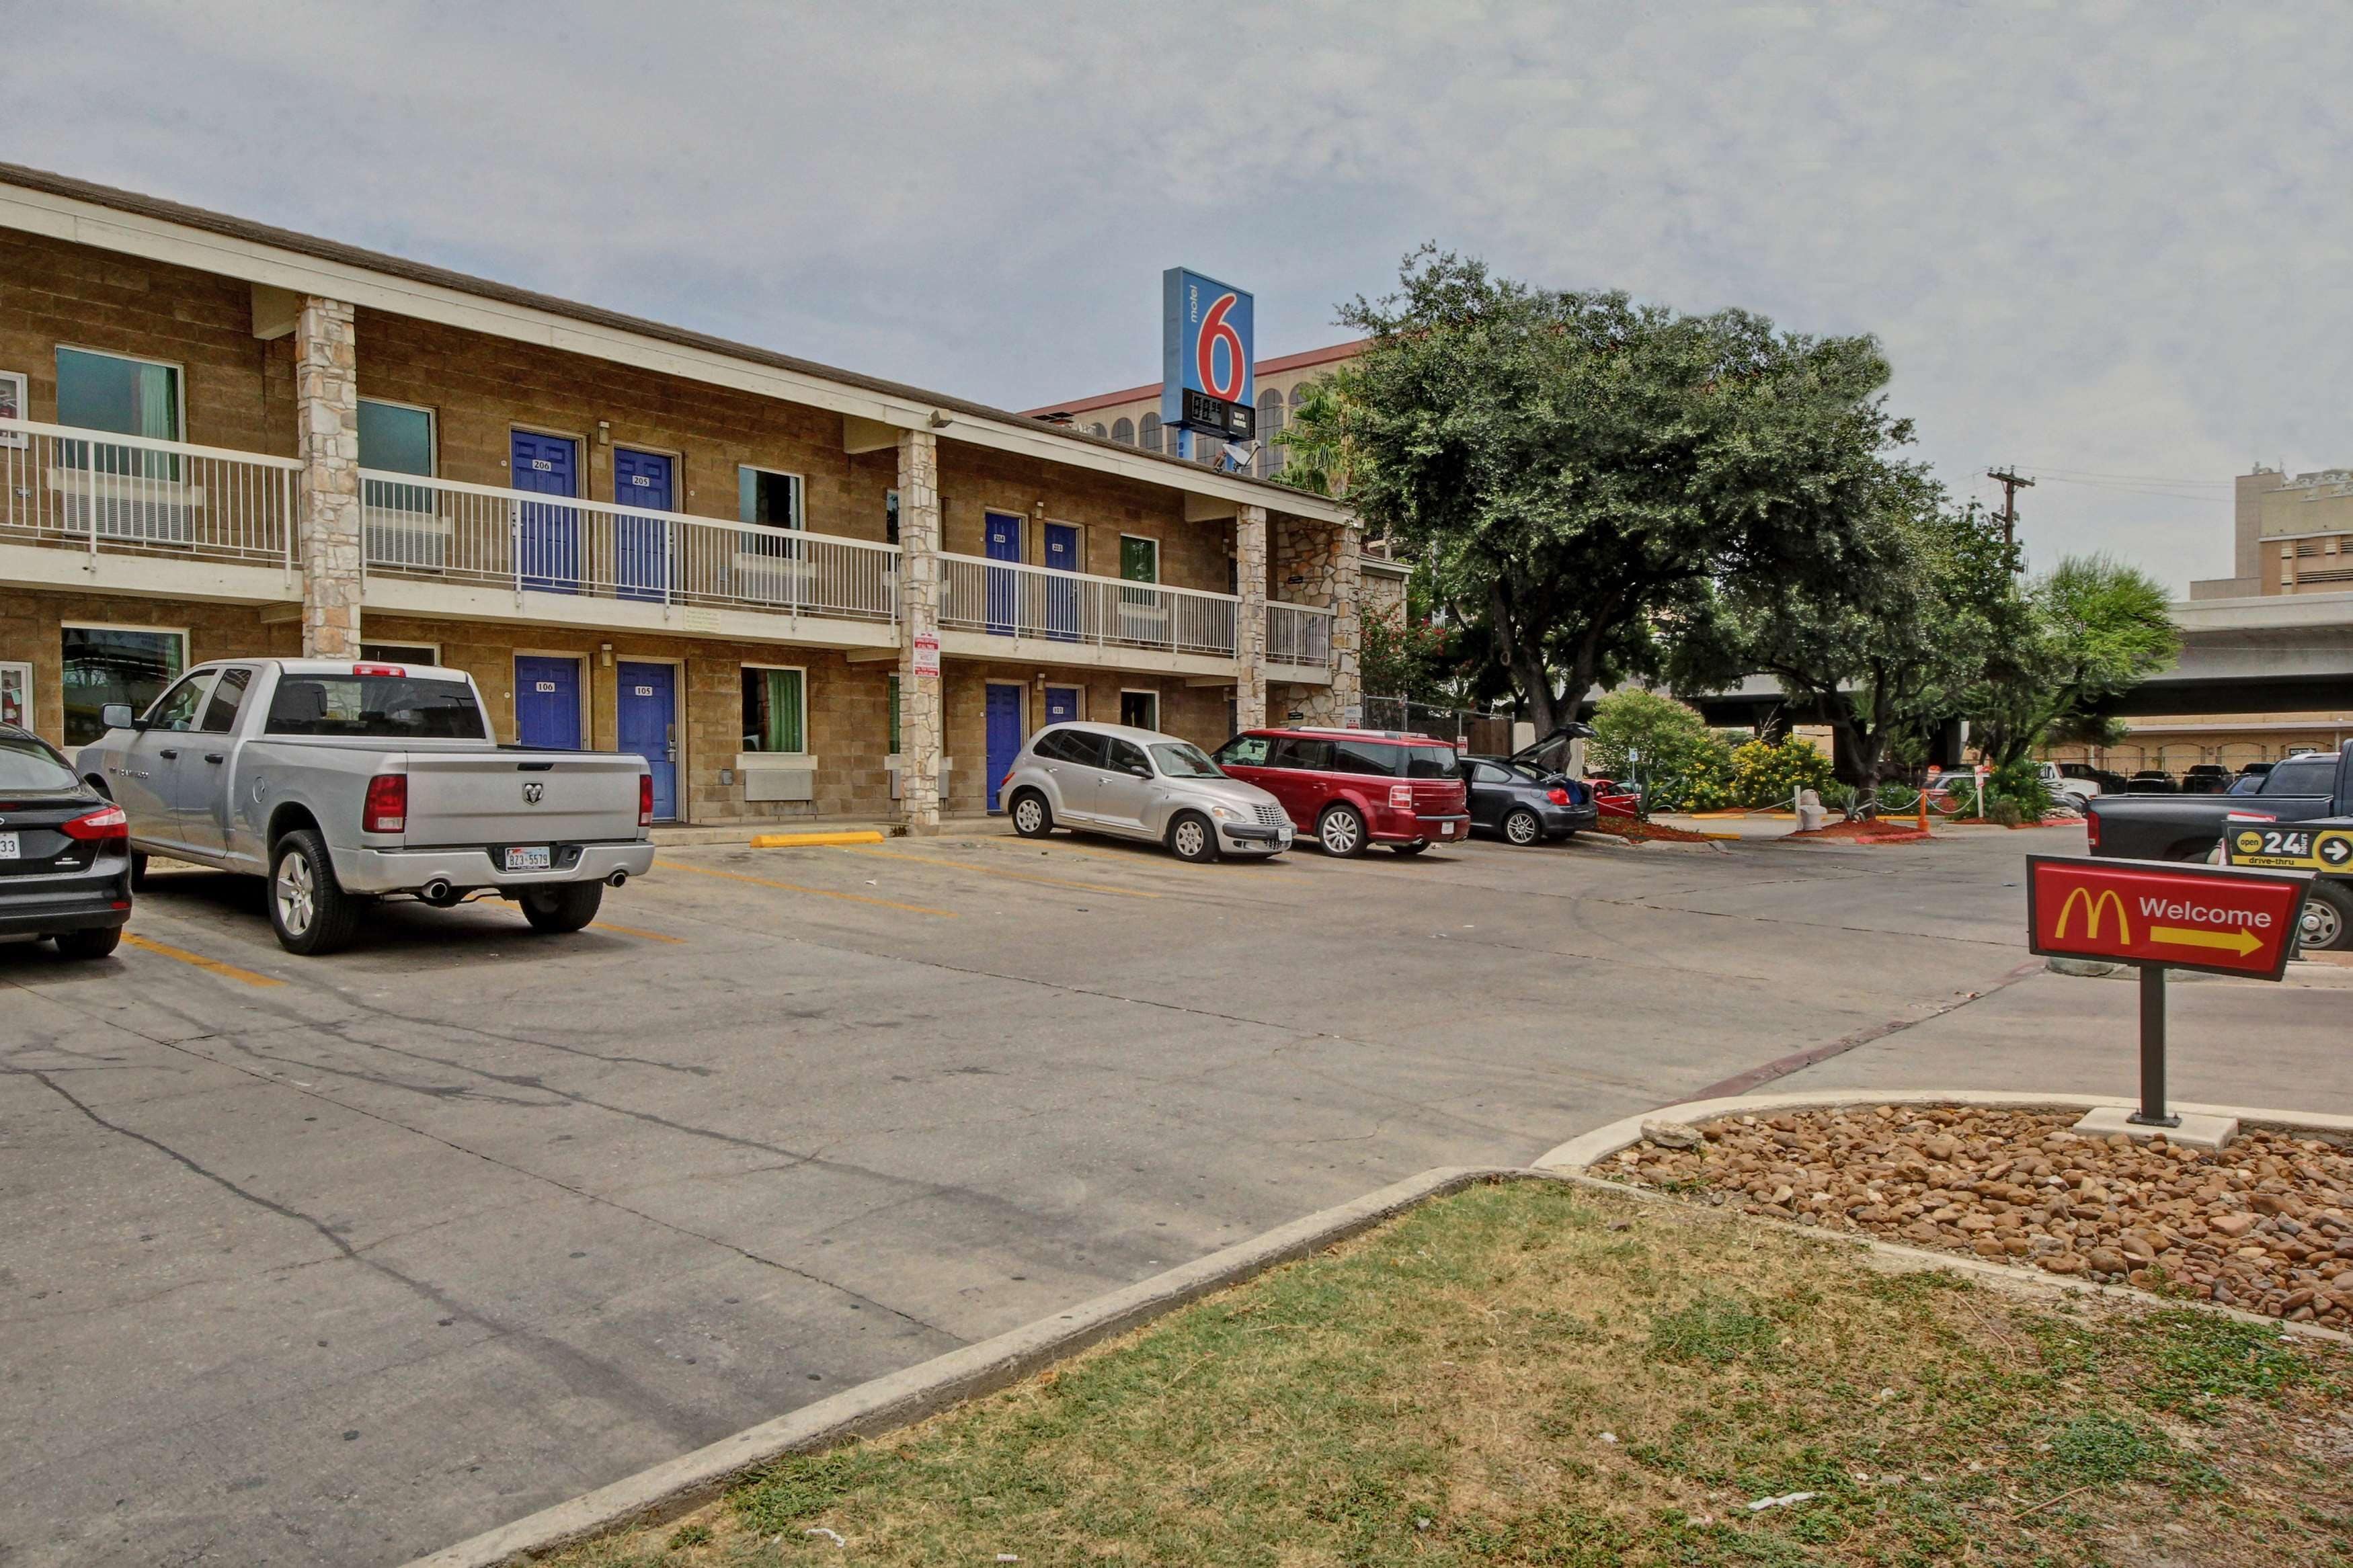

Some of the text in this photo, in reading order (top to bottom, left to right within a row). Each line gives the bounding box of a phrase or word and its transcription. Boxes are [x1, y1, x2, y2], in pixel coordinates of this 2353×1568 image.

[1190, 285, 1198, 323] motel
[1197, 292, 1246, 403] 6
[534, 461, 550, 470] 206
[633, 477, 648, 485] 205
[538, 683, 553, 691] 106
[2264, 831, 2301, 854] 24
[2299, 833, 2308, 855] hours
[2248, 857, 2295, 866] drive-thru
[2139, 897, 2272, 928] Welcome
